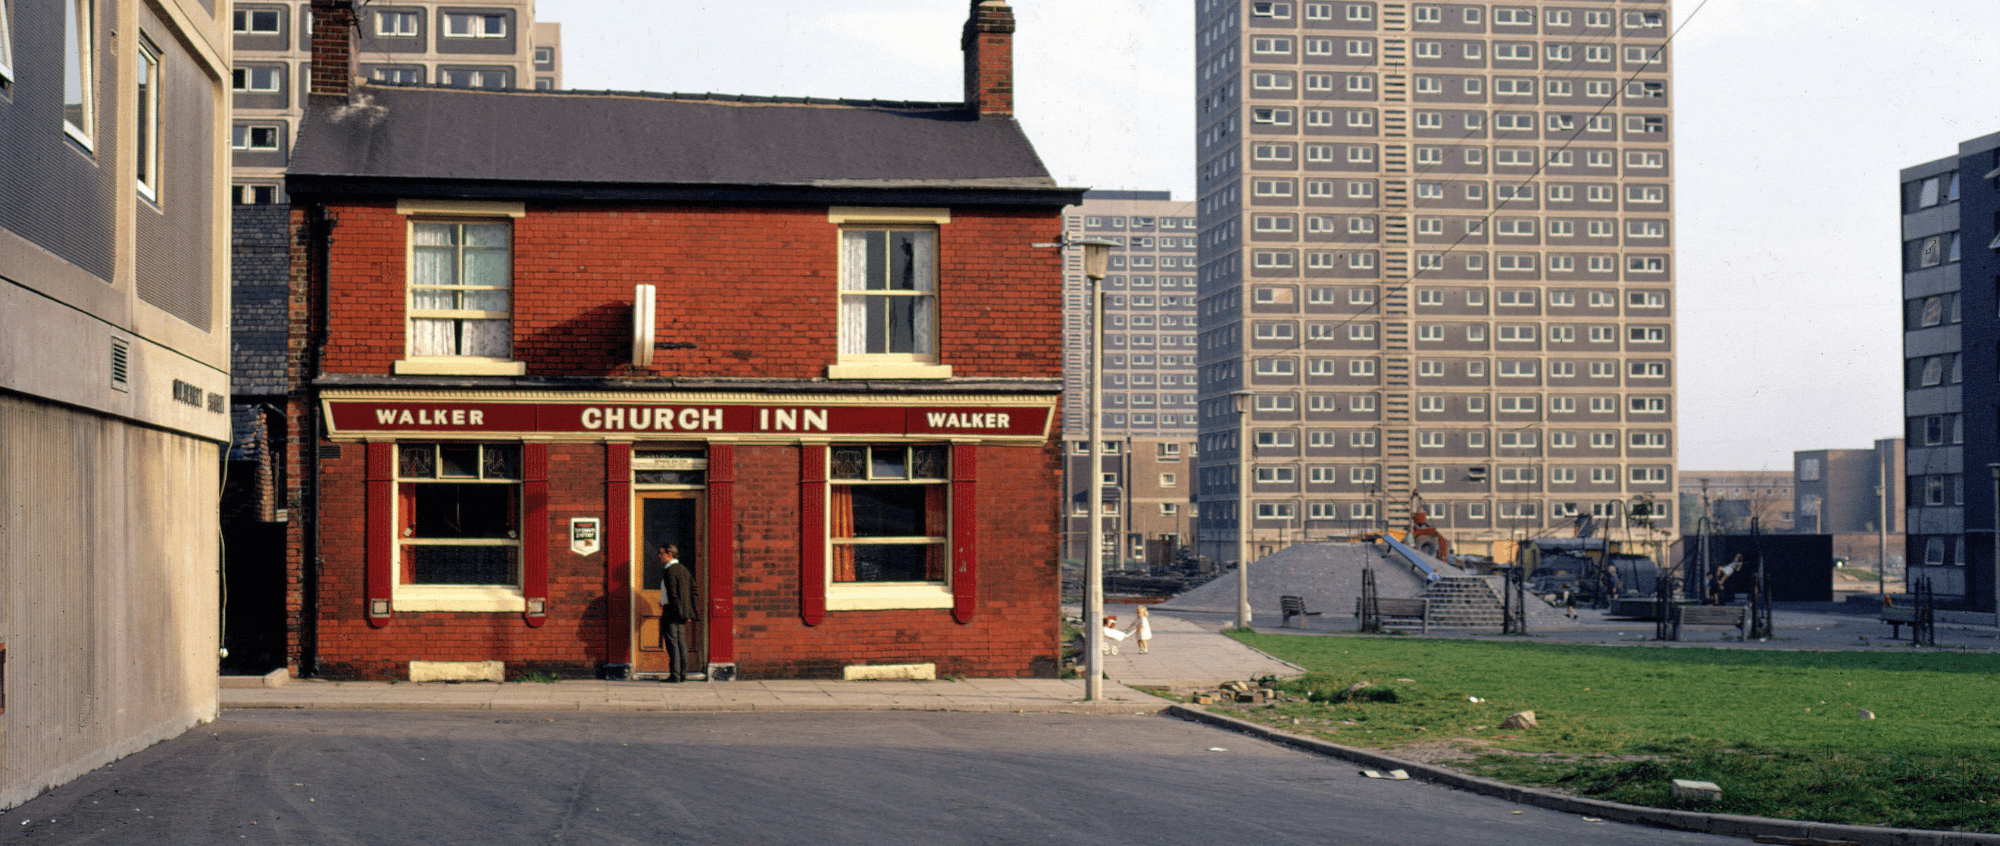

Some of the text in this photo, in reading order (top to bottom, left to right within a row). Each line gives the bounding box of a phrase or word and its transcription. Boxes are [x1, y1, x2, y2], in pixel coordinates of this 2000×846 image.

[376, 409, 484, 425] WALKER
[581, 407, 828, 431] CHURCH INN
[927, 412, 1010, 428] WALKER
